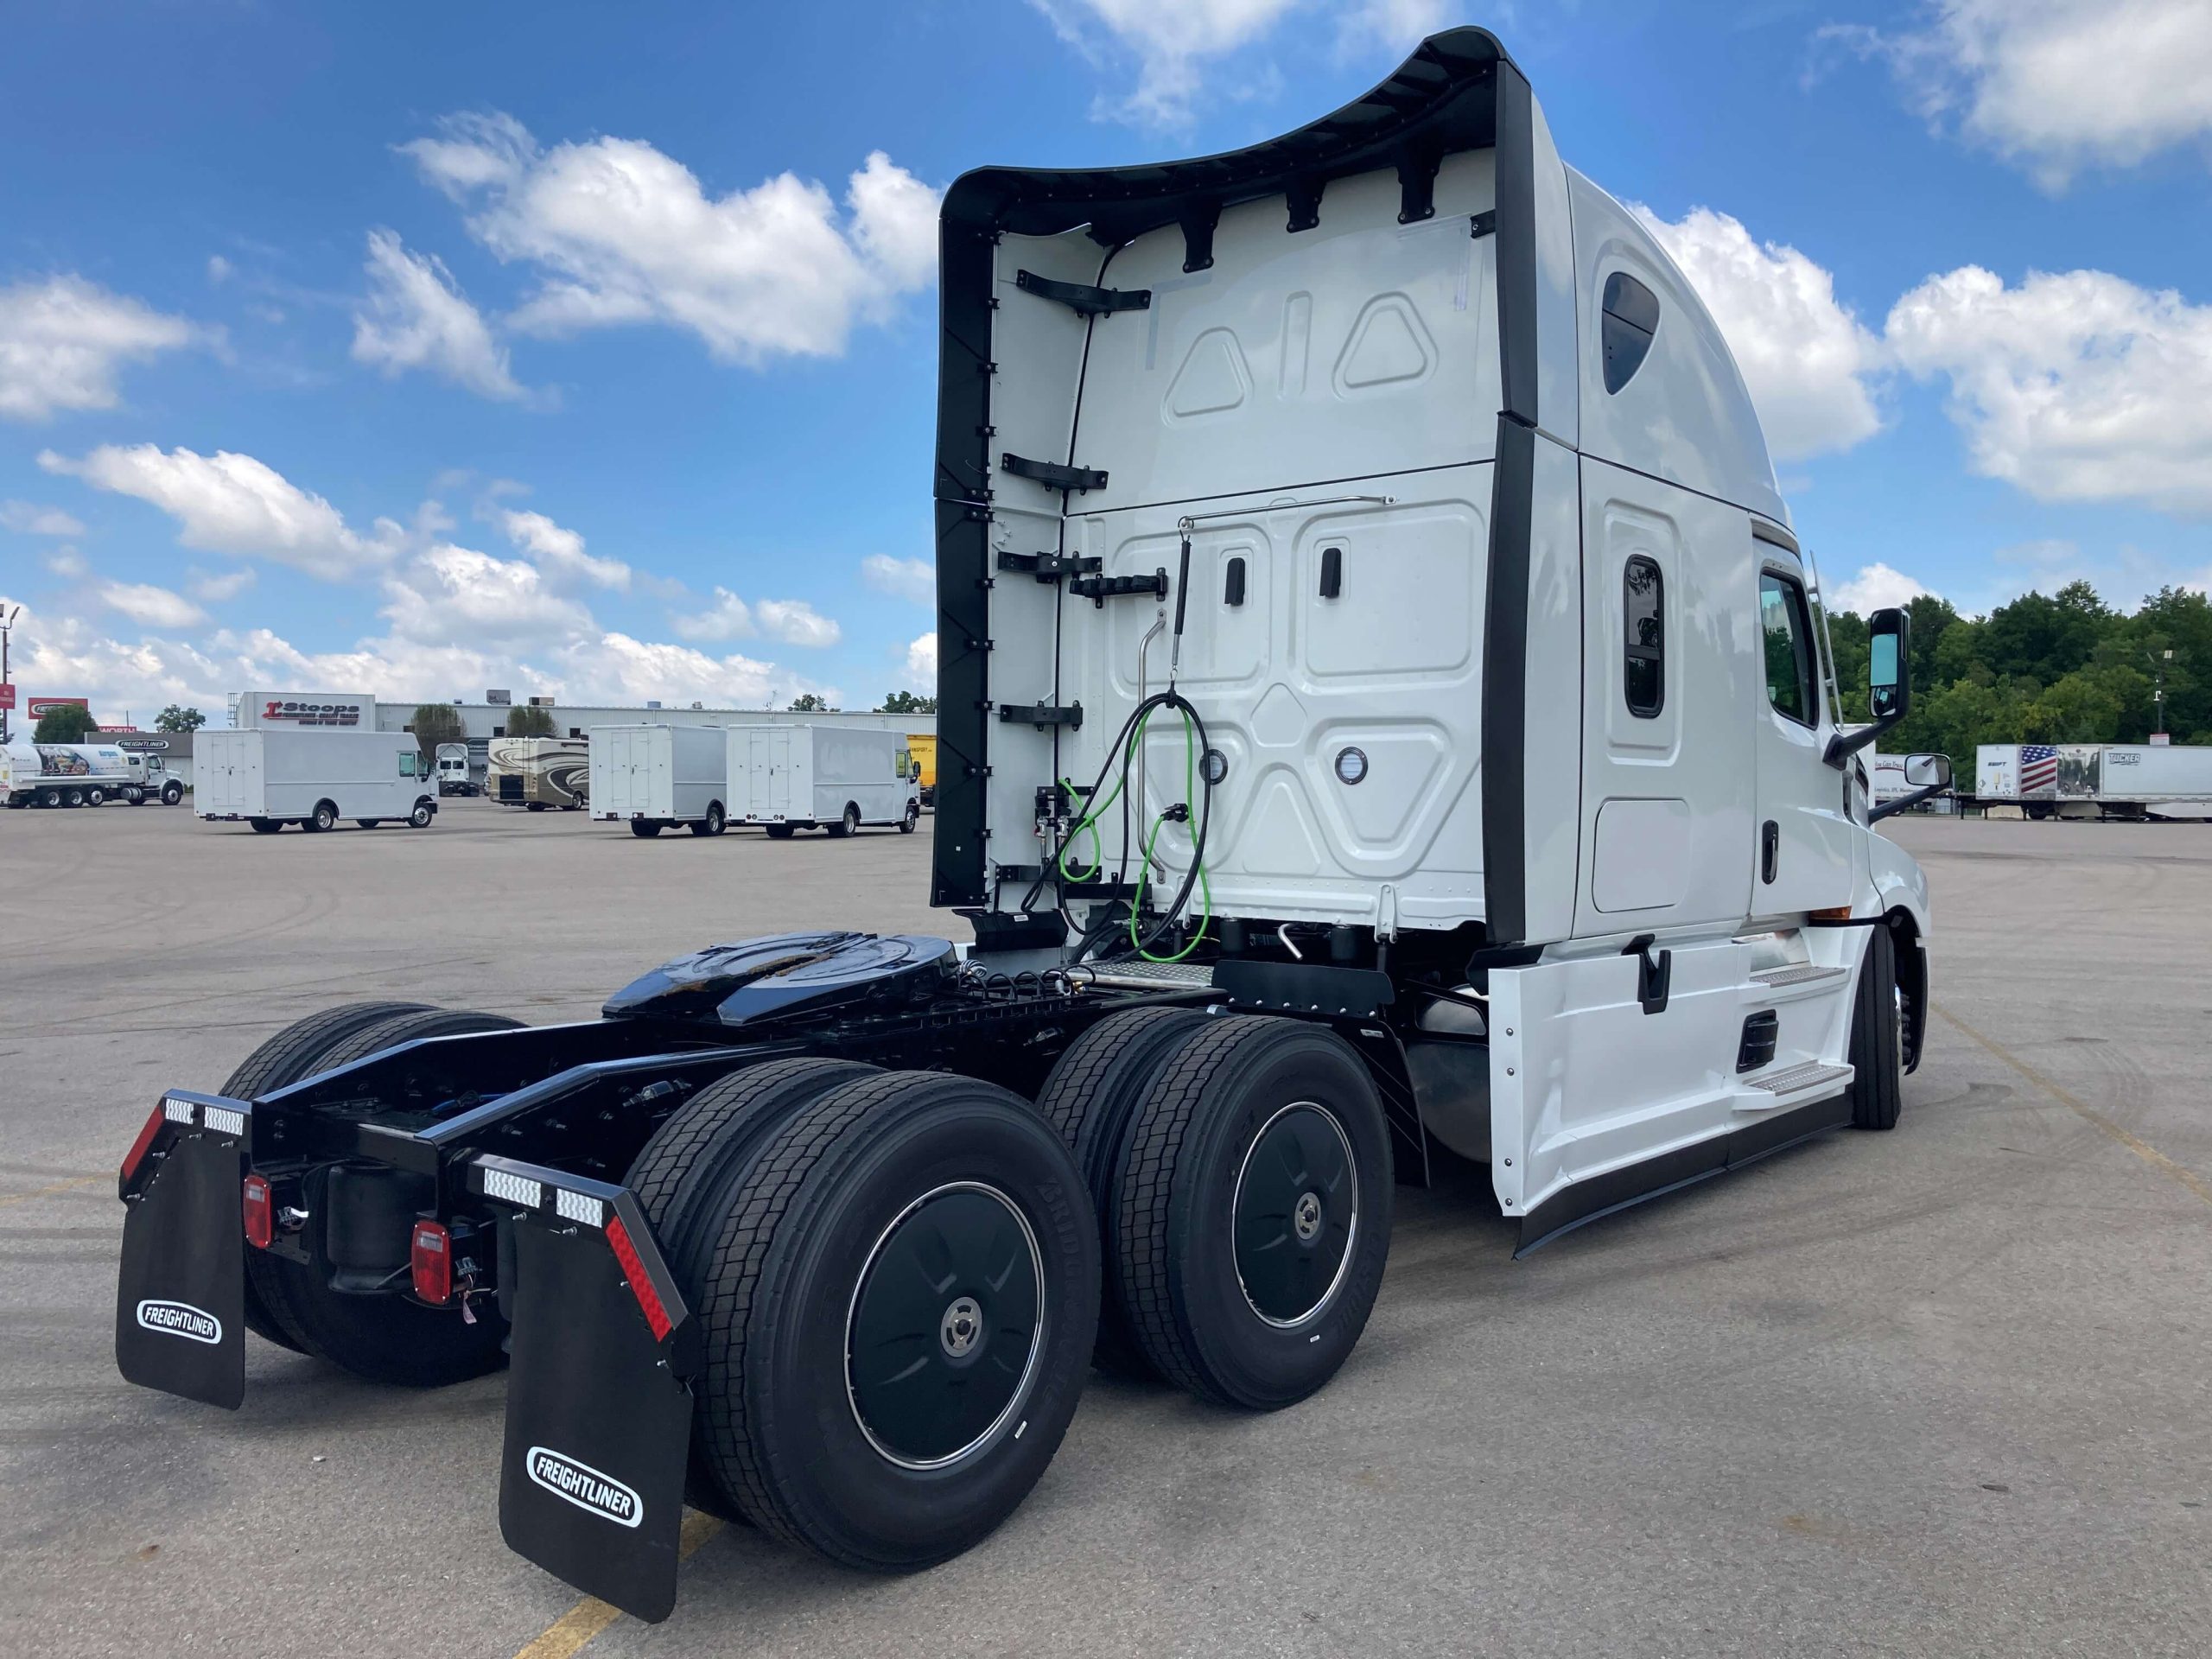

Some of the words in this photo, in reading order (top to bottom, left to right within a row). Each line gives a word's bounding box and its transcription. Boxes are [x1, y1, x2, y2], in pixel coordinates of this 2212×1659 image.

[283, 702, 359, 715] Stoops
[2108, 753, 2140, 762] TUCKER
[144, 1306, 213, 1337] FREIGHTLINER
[536, 1456, 632, 1516] FREIGHTLINER
